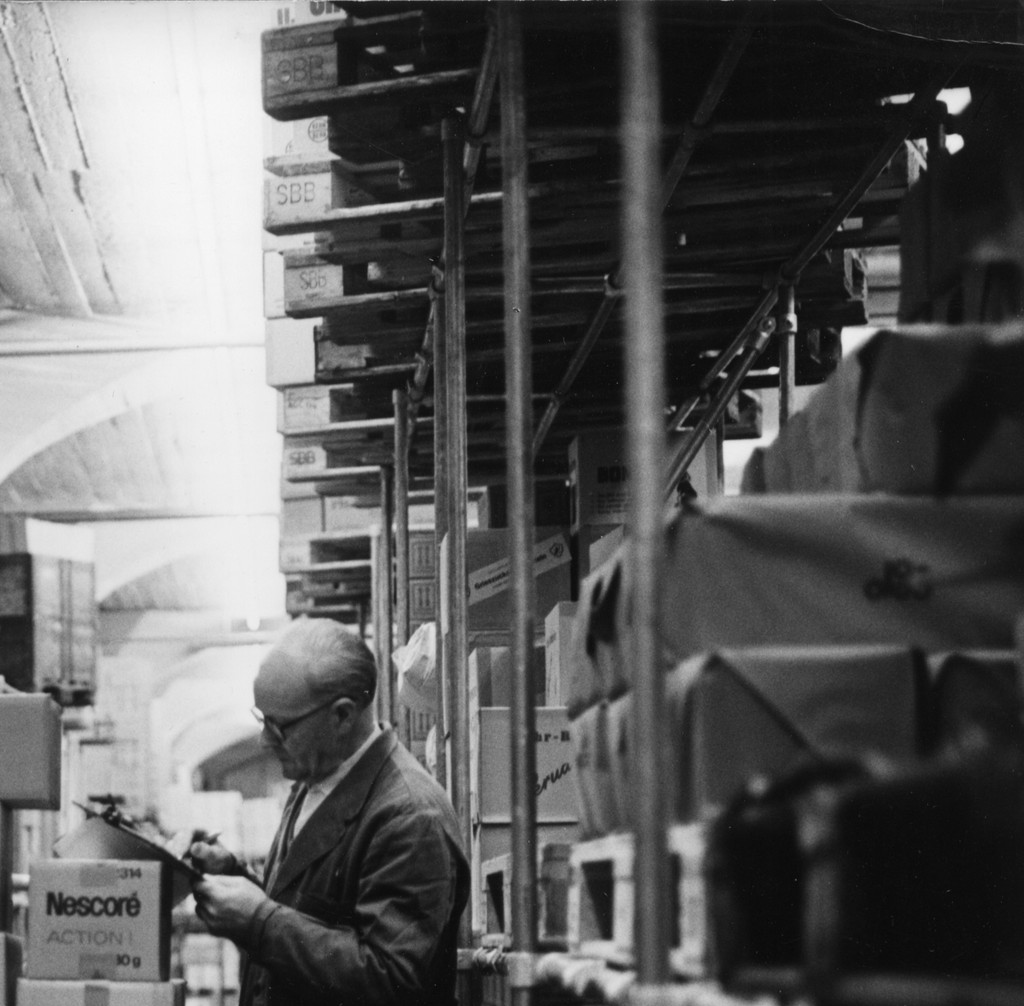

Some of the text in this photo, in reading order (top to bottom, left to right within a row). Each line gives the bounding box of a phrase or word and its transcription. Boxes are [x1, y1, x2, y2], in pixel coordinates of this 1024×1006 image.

[277, 55, 324, 82] SBB
[276, 182, 315, 205] SBB
[289, 451, 315, 466] SBB
[46, 892, 141, 917] Nescoré
[47, 930, 122, 945] ACTION
